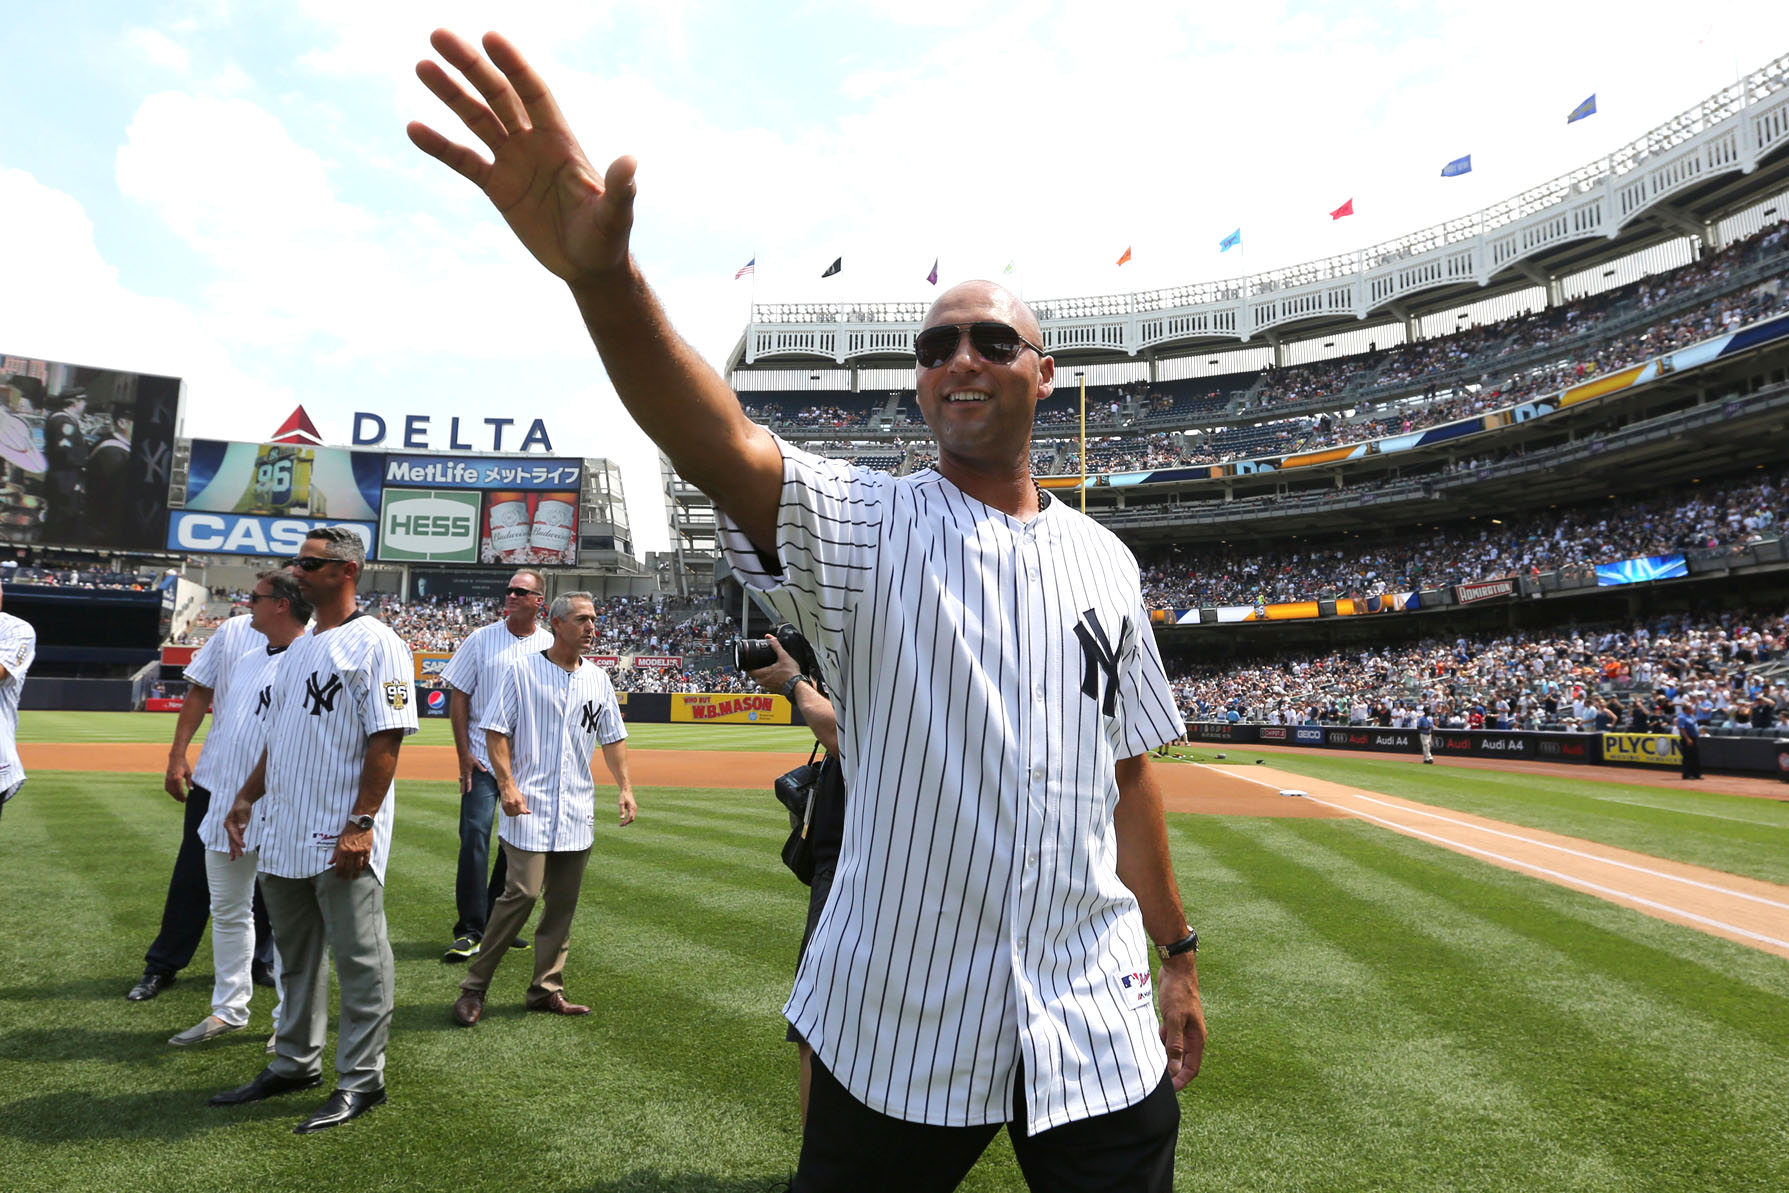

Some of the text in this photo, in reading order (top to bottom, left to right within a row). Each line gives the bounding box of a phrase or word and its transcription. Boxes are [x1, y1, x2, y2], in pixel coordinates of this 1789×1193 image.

[352, 412, 552, 451] DELTA
[256, 459, 292, 492] 96
[386, 461, 478, 484] MetLife
[484, 466, 580, 485] メットライフ
[177, 514, 372, 554] CASO
[390, 514, 470, 537] HESS
[303, 671, 343, 716] NY
[580, 700, 602, 734] NY
[692, 696, 773, 719] W.B.MASON
[1297, 730, 1320, 739] GEICO
[1349, 734, 1368, 744] Audi
[1376, 736, 1408, 746] Audi A4
[1447, 738, 1471, 749] Audi
[1481, 739, 1524, 750] Audi A4
